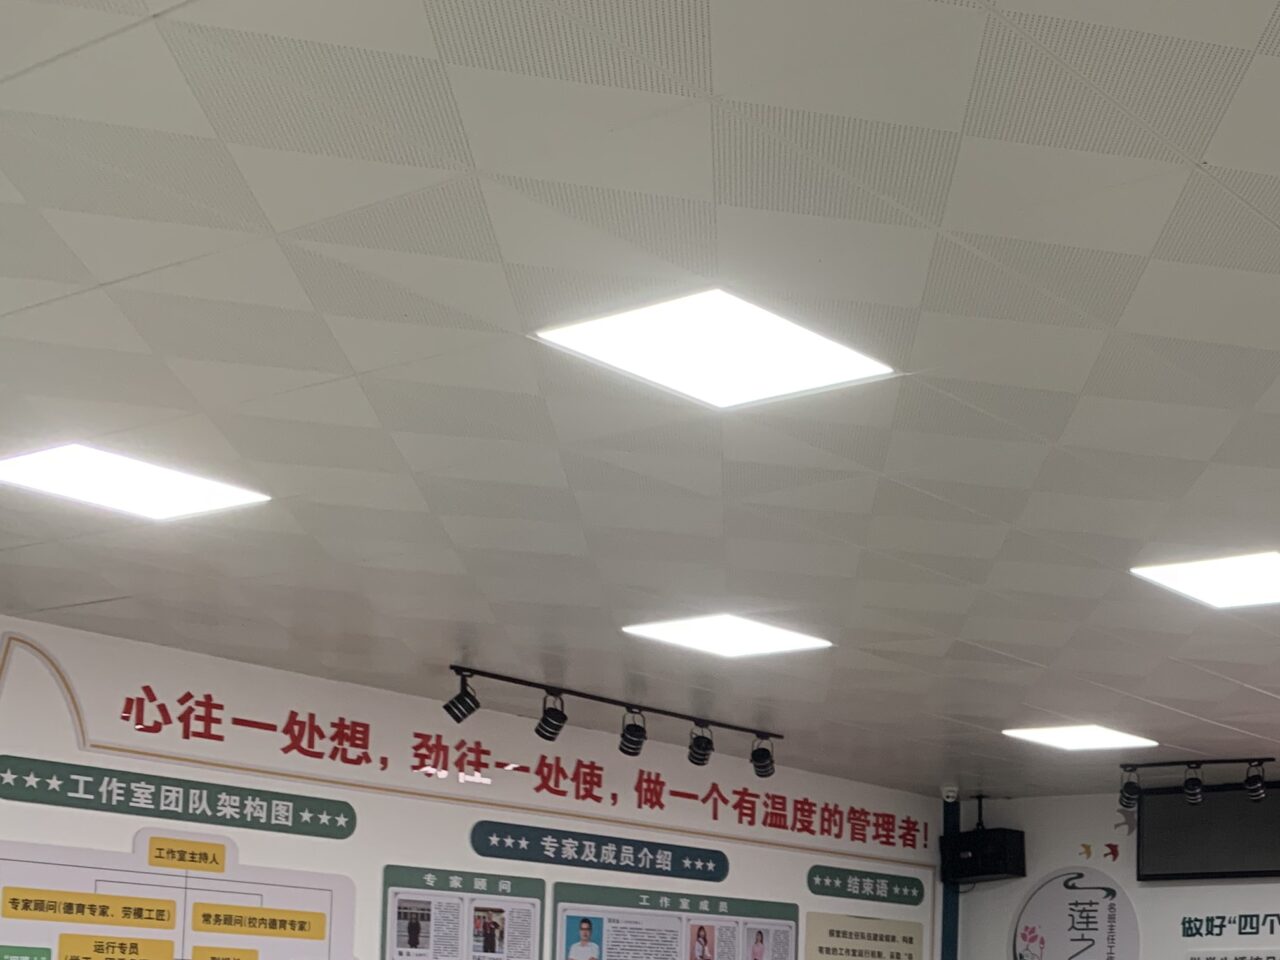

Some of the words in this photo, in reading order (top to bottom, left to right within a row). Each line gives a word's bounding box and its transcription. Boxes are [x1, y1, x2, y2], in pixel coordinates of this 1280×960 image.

[67, 773, 294, 828] 工作室团队架构图
[155, 848, 219, 865] 工作室主持人
[541, 835, 673, 872] 专家及成员介绍
[423, 873, 512, 893] 专家顾问
[847, 875, 889, 898] 结束语
[638, 895, 729, 913] 工作室成员
[93, 940, 140, 955] 运行专员
